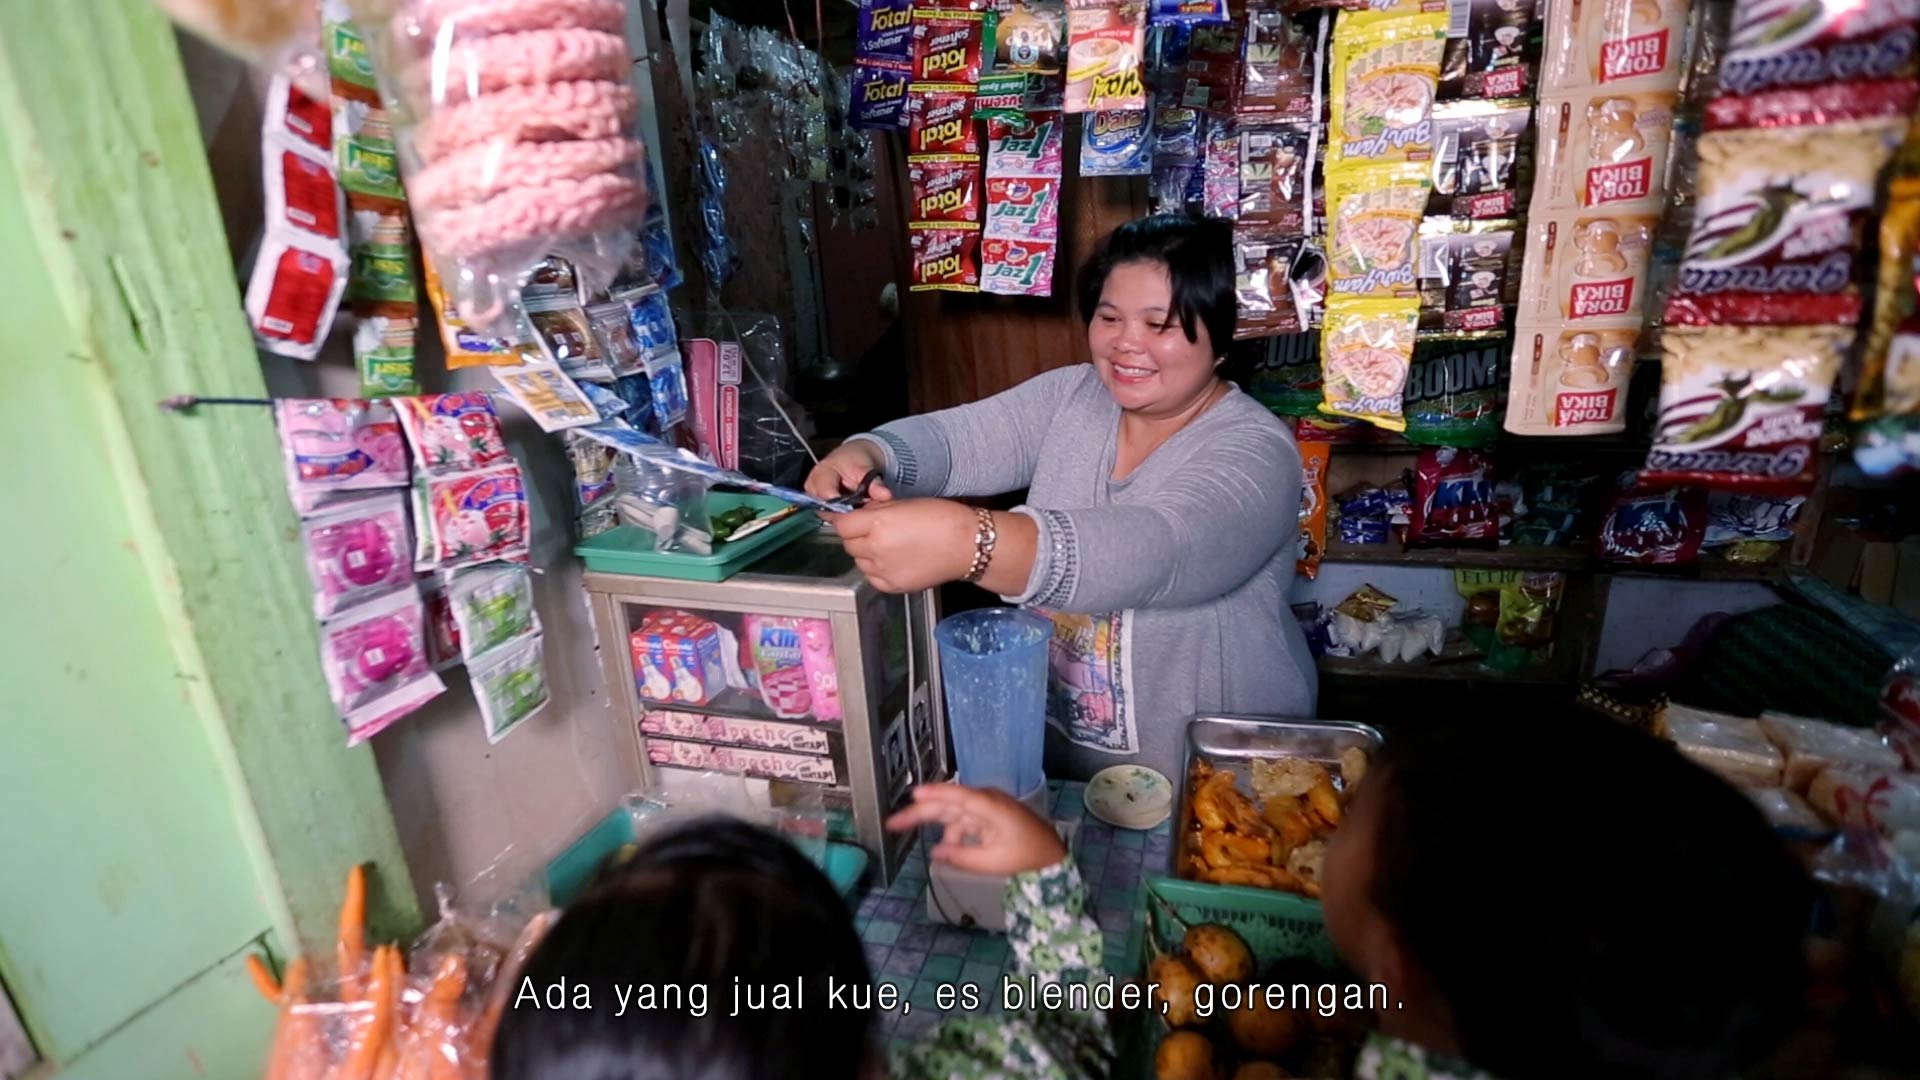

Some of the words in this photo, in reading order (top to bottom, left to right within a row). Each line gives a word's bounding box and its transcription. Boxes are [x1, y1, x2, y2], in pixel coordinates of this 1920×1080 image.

[870, 4, 912, 31] Total
[868, 35, 903, 51] Softener
[928, 28, 969, 46] Softener
[1605, 37, 1660, 61] BIKA
[922, 47, 967, 80] Total
[1604, 55, 1660, 76] TORA
[1485, 80, 1520, 97] TORA
[1486, 71, 1519, 85] BIKA
[863, 76, 905, 102] Total
[926, 98, 966, 120] Softener
[920, 119, 965, 151] Total
[925, 170, 963, 189] Softener
[1588, 164, 1642, 186] BIKA
[921, 188, 965, 218] Total
[1473, 196, 1505, 209] BIKA
[1590, 180, 1643, 207] TORA
[920, 253, 963, 283] Total
[1576, 284, 1626, 302] BIKA
[1574, 297, 1626, 317] TORA
[1405, 347, 1498, 400] BOOM
[1558, 394, 1608, 413] BIKA
[1556, 407, 1609, 427] TORA
